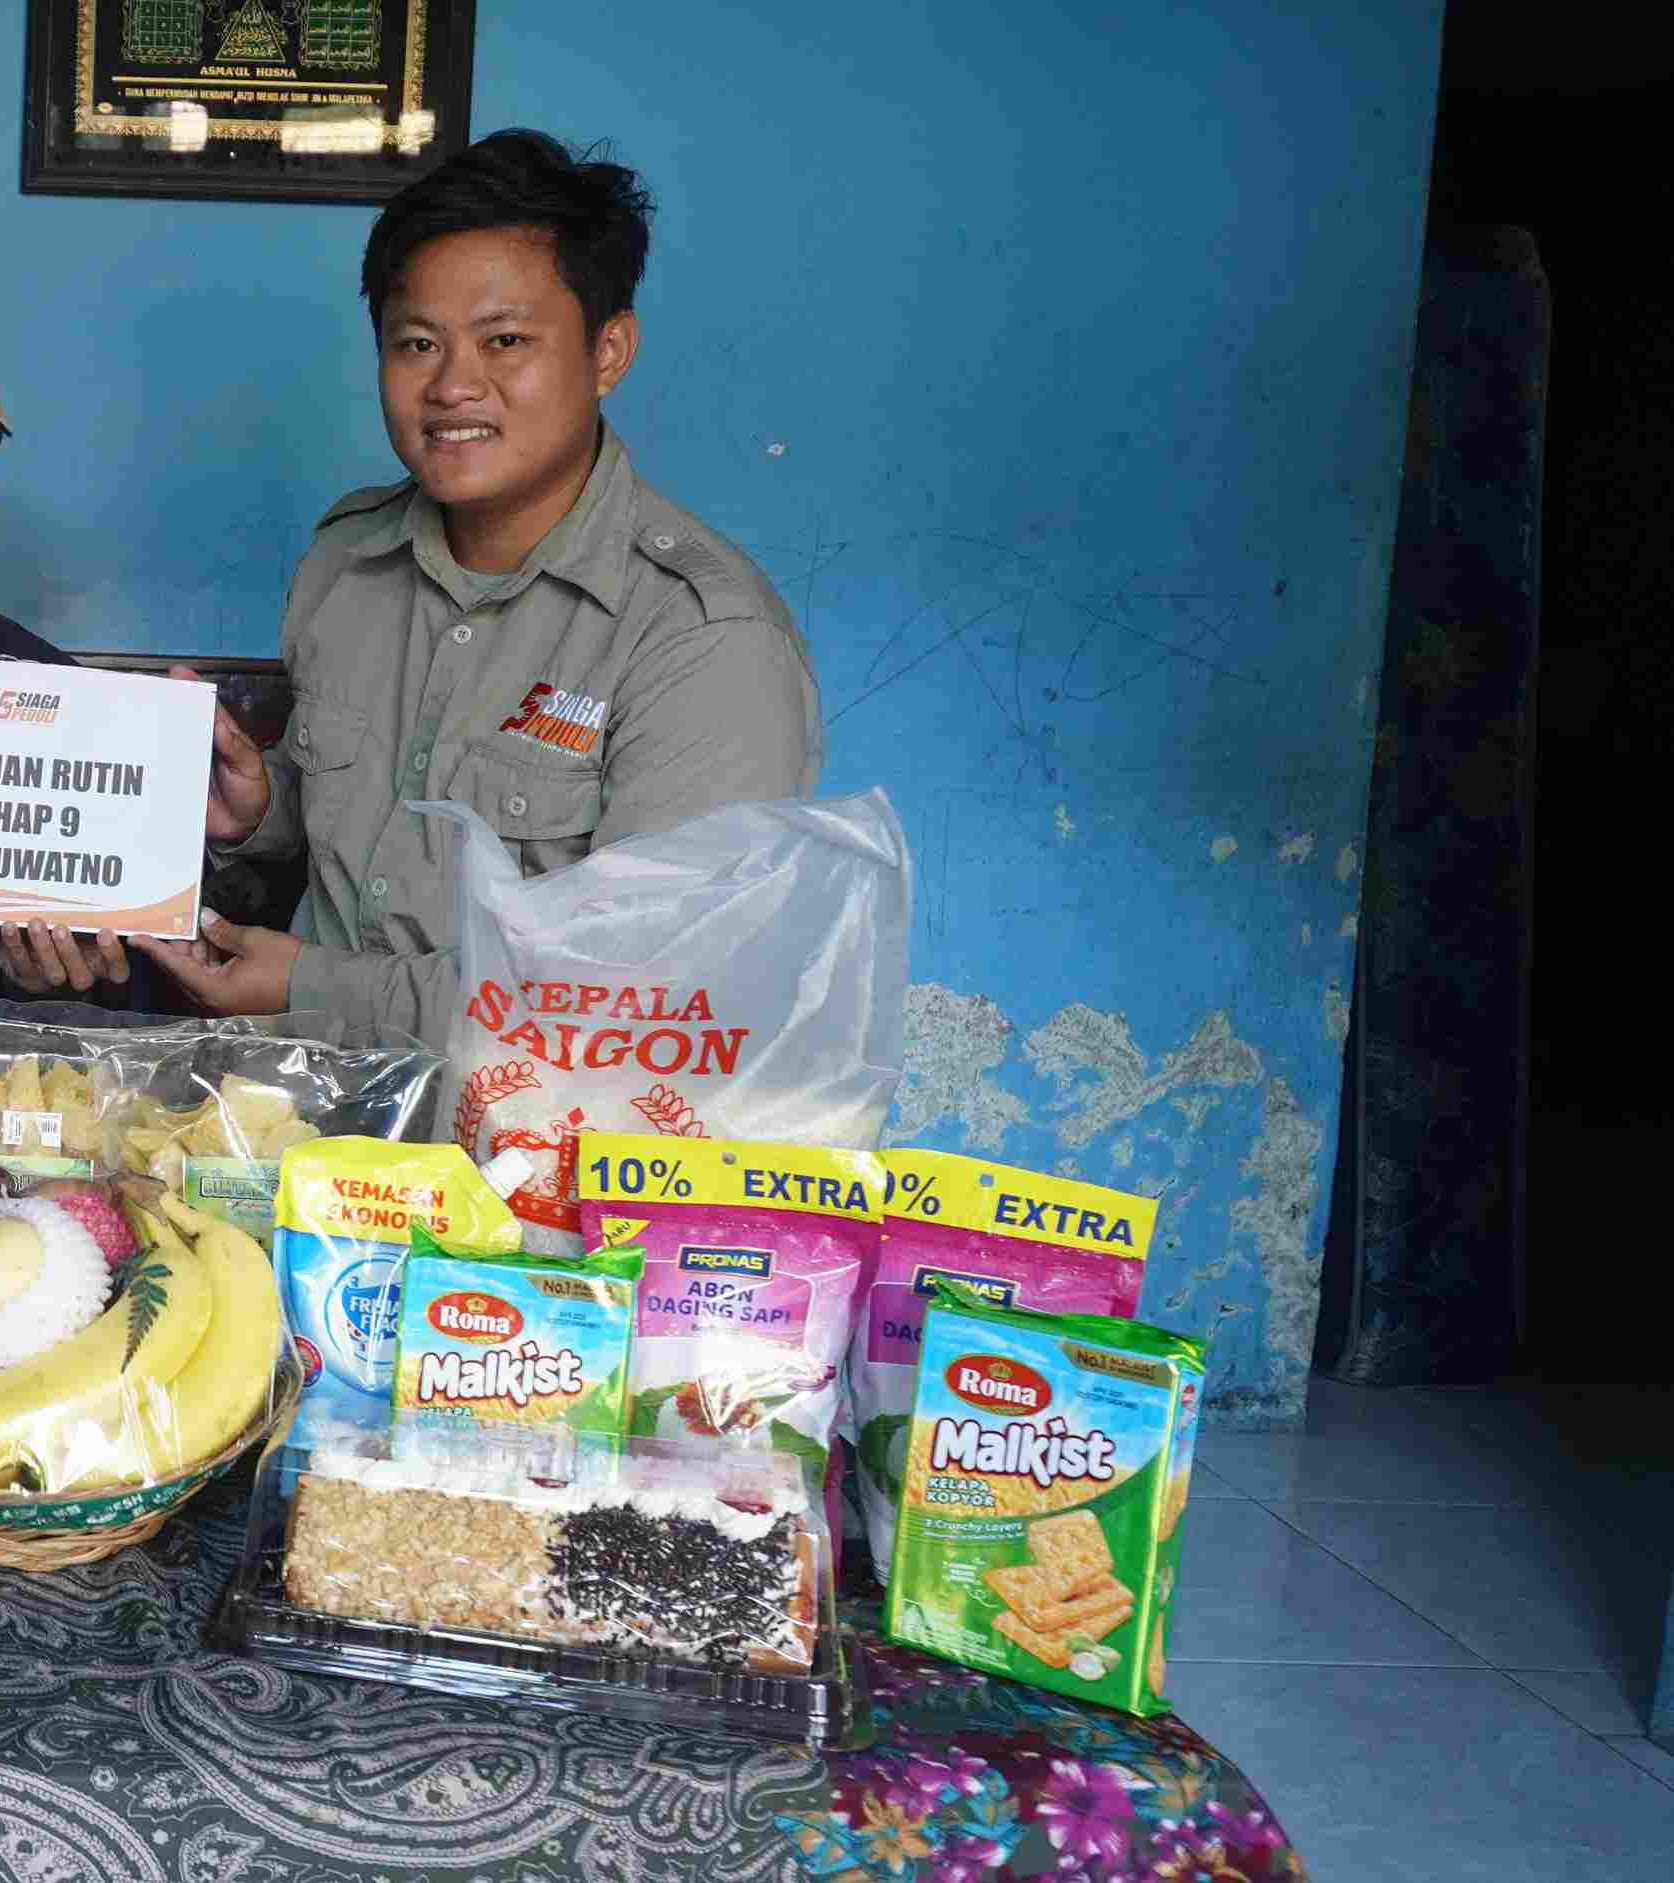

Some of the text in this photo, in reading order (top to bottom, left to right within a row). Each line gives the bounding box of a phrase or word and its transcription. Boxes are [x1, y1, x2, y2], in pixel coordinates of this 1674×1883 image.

[256, 67, 297, 79] HUSNA
[16, 692, 62, 710] SIAGA
[50, 758, 145, 796] RUTIN
[59, 806, 81, 838] 9
[468, 980, 750, 1075] SAIGON
[589, 1156, 870, 1213] 10% EXTRA
[605, 1221, 631, 1248] ARU
[993, 1193, 1135, 1246] EXTRA
[686, 1252, 764, 1270] PRONAS
[687, 1281, 754, 1303] ABON
[439, 1305, 511, 1335] Roma
[646, 1295, 791, 1325] DAGING SAPI
[419, 1341, 583, 1408] Malkist
[958, 1367, 1038, 1408] Roma
[931, 1416, 1116, 1489] Malkist
[927, 1475, 990, 1491] KELAPA
[926, 1490, 995, 1507] KOPYOR
